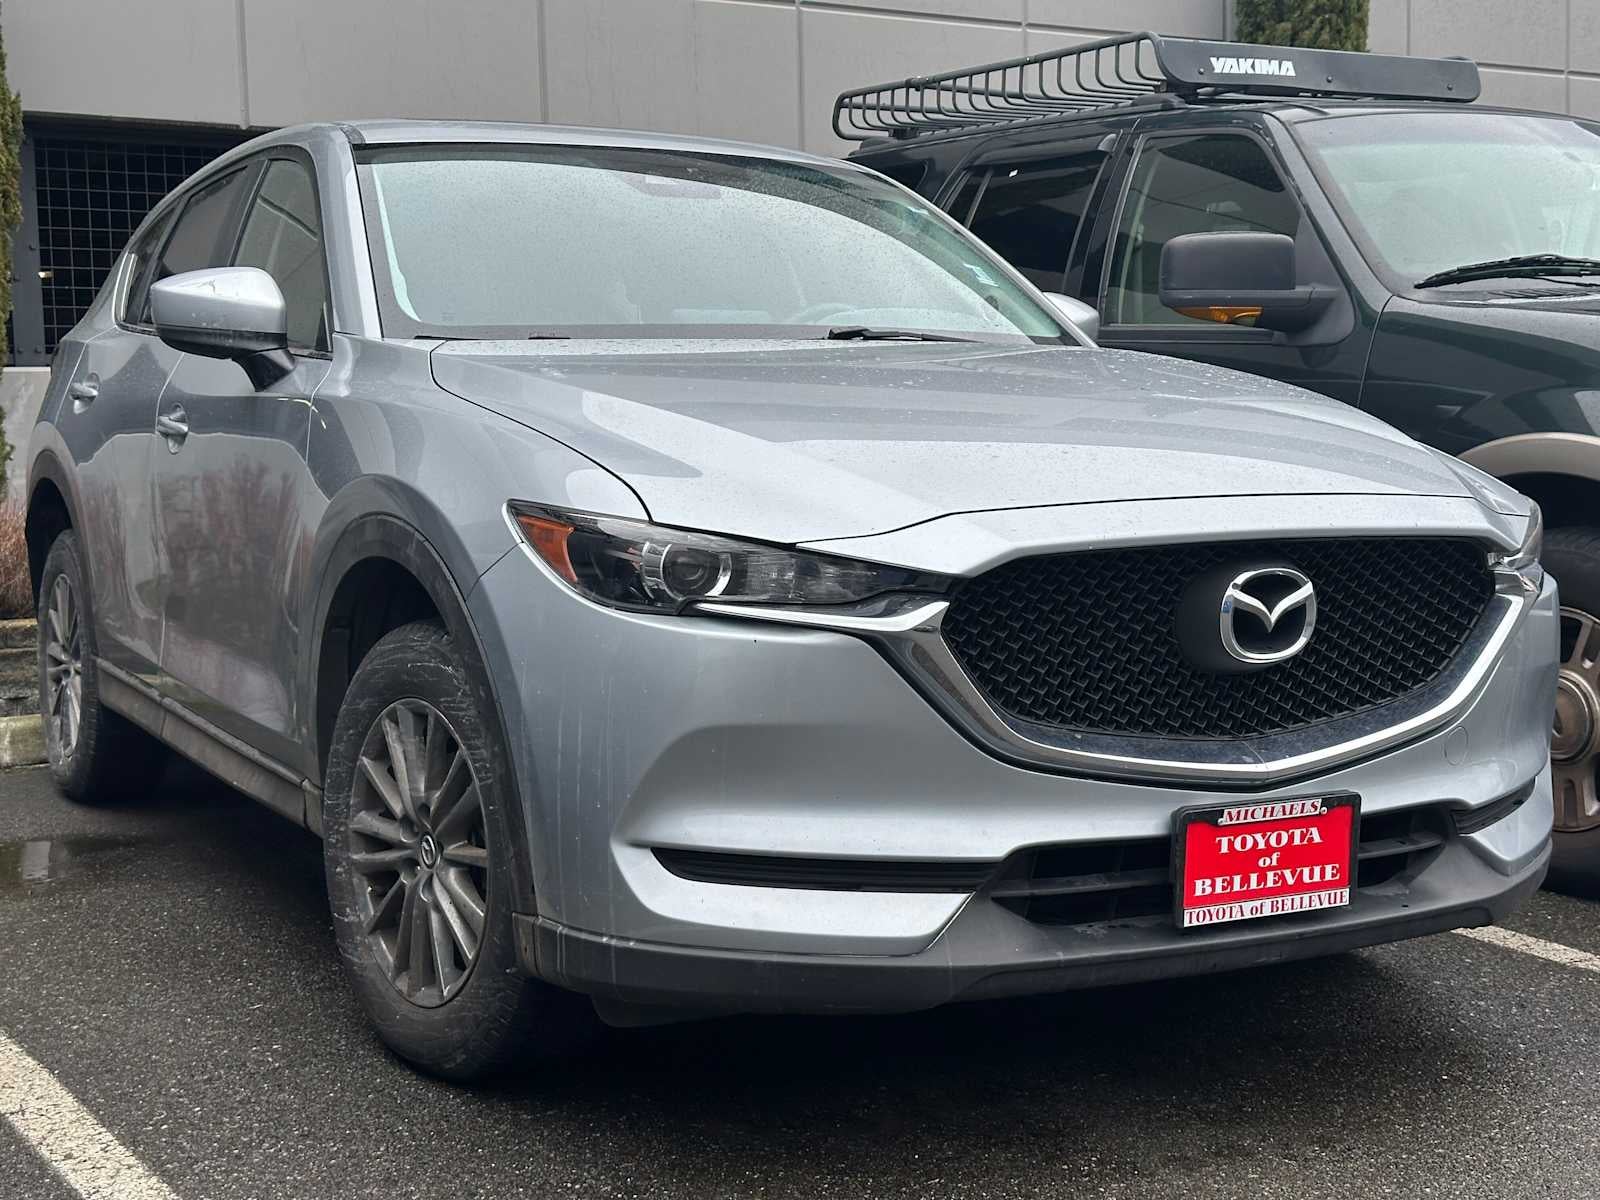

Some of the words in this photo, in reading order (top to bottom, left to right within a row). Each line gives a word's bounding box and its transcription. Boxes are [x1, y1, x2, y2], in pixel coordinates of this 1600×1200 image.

[1210, 56, 1296, 76] YAKIMA
[1225, 801, 1319, 822] MICHAELS
[1216, 827, 1322, 854] TOYOTA
[1258, 852, 1280, 868] of
[1194, 863, 1340, 897] BELLEVUE
[1187, 906, 1244, 924] TOYOTA
[1250, 903, 1265, 916] of
[1270, 890, 1347, 912] BELLEVUE
